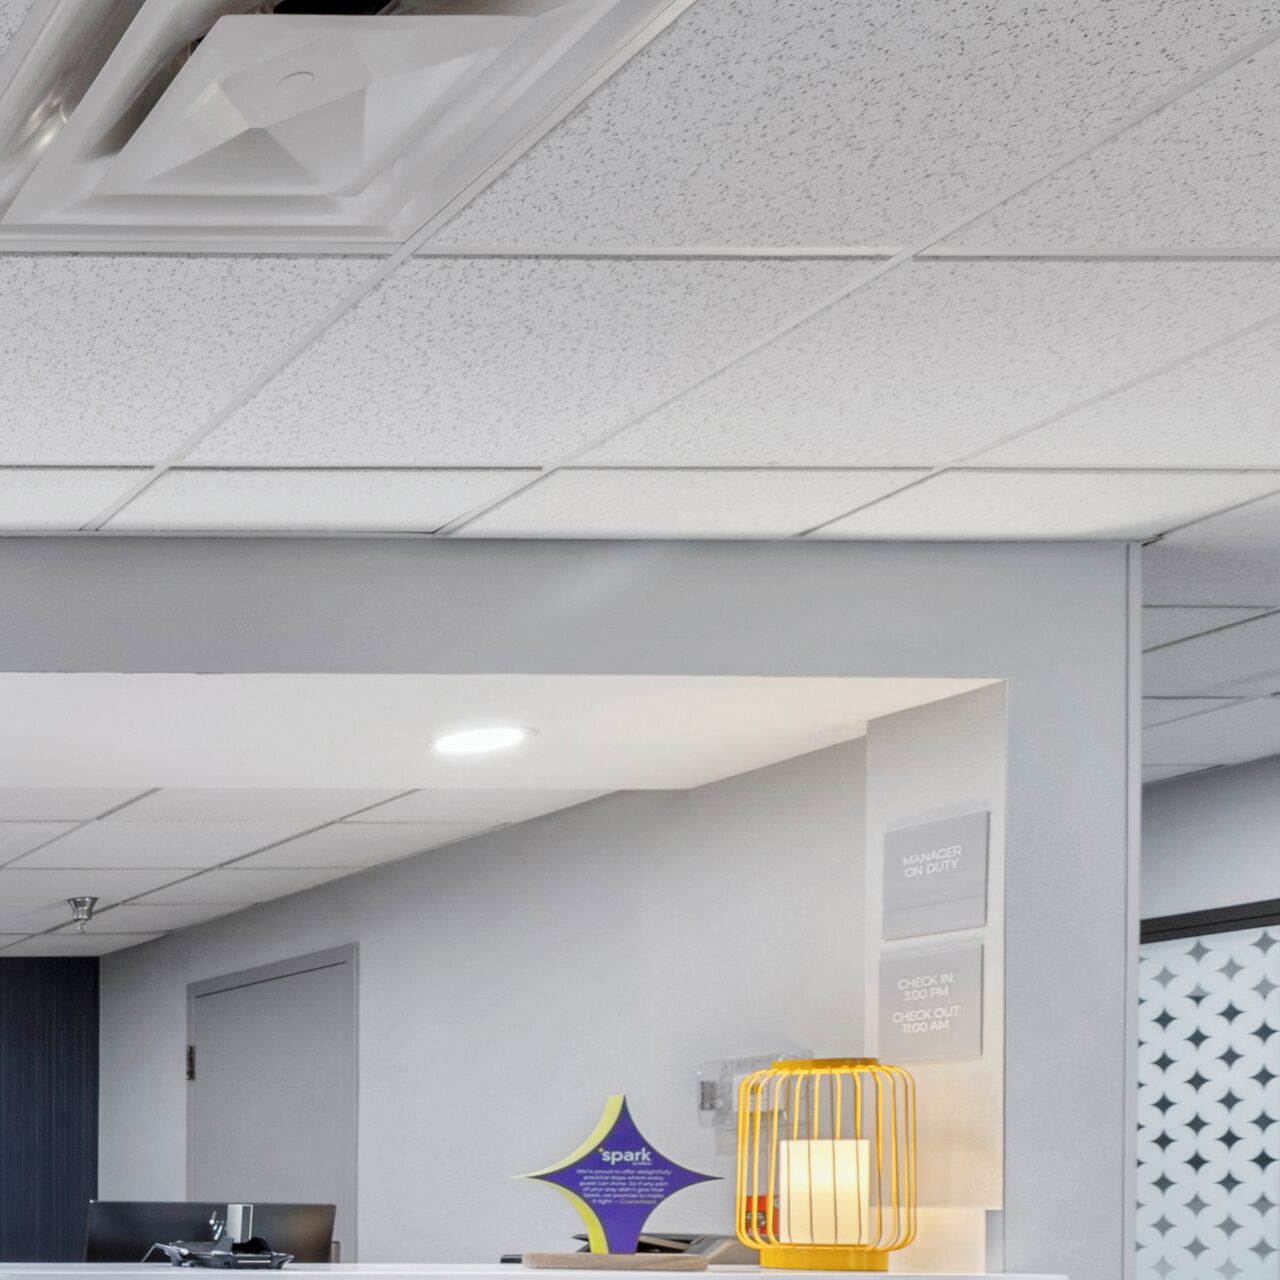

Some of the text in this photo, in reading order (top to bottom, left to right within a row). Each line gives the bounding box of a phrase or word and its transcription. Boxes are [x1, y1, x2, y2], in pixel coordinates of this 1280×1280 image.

[903, 845, 962, 866] MANAGER
[904, 858, 960, 878] ON DUTY
[898, 975, 938, 990] CHECK
[904, 986, 949, 1002] 3:00 PM
[892, 1010, 932, 1023] CHECK
[902, 1020, 950, 1034] 11:00 AM
[602, 1148, 652, 1166] spark
